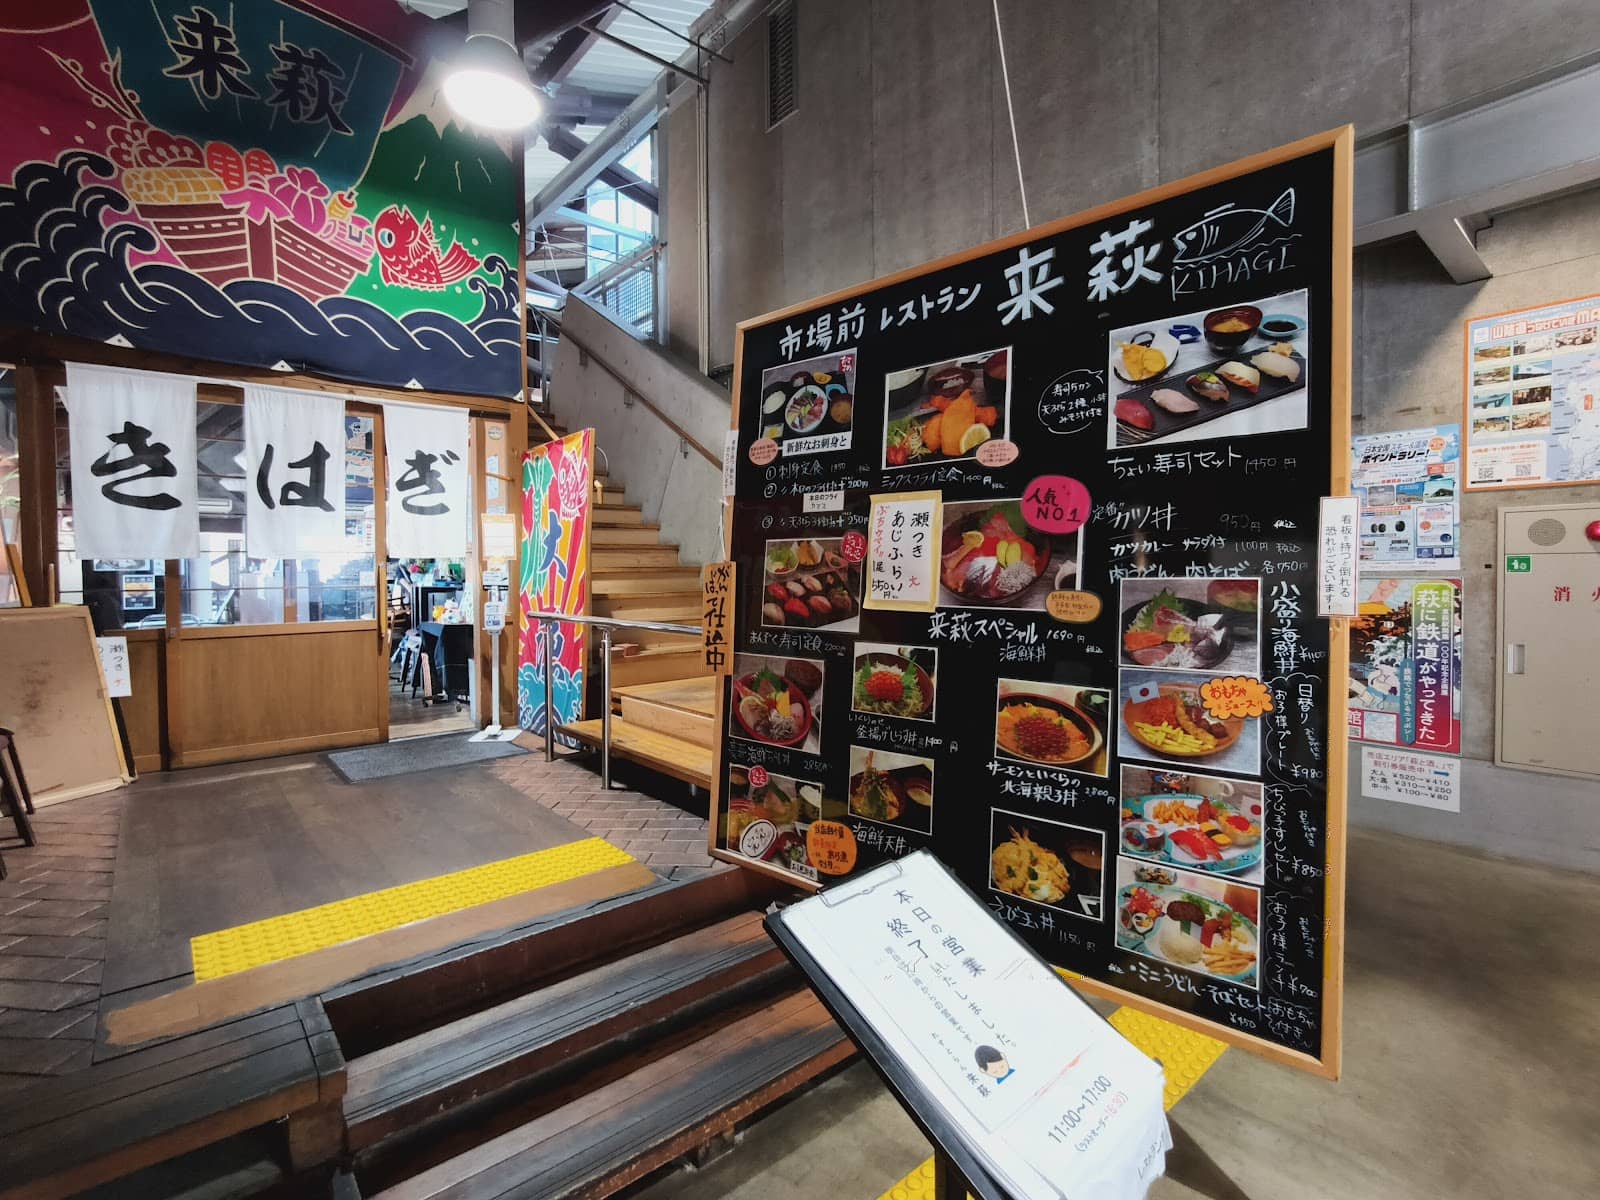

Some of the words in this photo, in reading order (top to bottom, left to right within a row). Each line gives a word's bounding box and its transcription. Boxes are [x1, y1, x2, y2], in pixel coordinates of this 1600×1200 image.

[163, 6, 353, 135] 来萩
[779, 302, 866, 361] 市場前
[880, 283, 981, 331] レストラン
[997, 217, 1163, 326] 来萩
[1171, 243, 1296, 302] KIHAGI
[787, 435, 848, 453] 新鮮なお刺身と
[880, 466, 963, 489] ミックスフライ定食
[1107, 444, 1242, 479] ちょい寿司セット
[1026, 486, 1059, 507] 人気
[888, 510, 905, 592] あじふらい
[910, 511, 930, 559] 瀬つき
[1110, 539, 1175, 557] カツカレー
[927, 611, 1038, 645] 来萩スペシャル
[999, 641, 1047, 663] 海鮮丼
[1416, 589, 1441, 741] 萩に鉄道がやってきた
[1209, 684, 1247, 699] おもちゃ
[1275, 690, 1292, 771] お子様プレート
[986, 760, 1080, 787] サーモンといくらの
[1000, 780, 1078, 807] 北海親子丼
